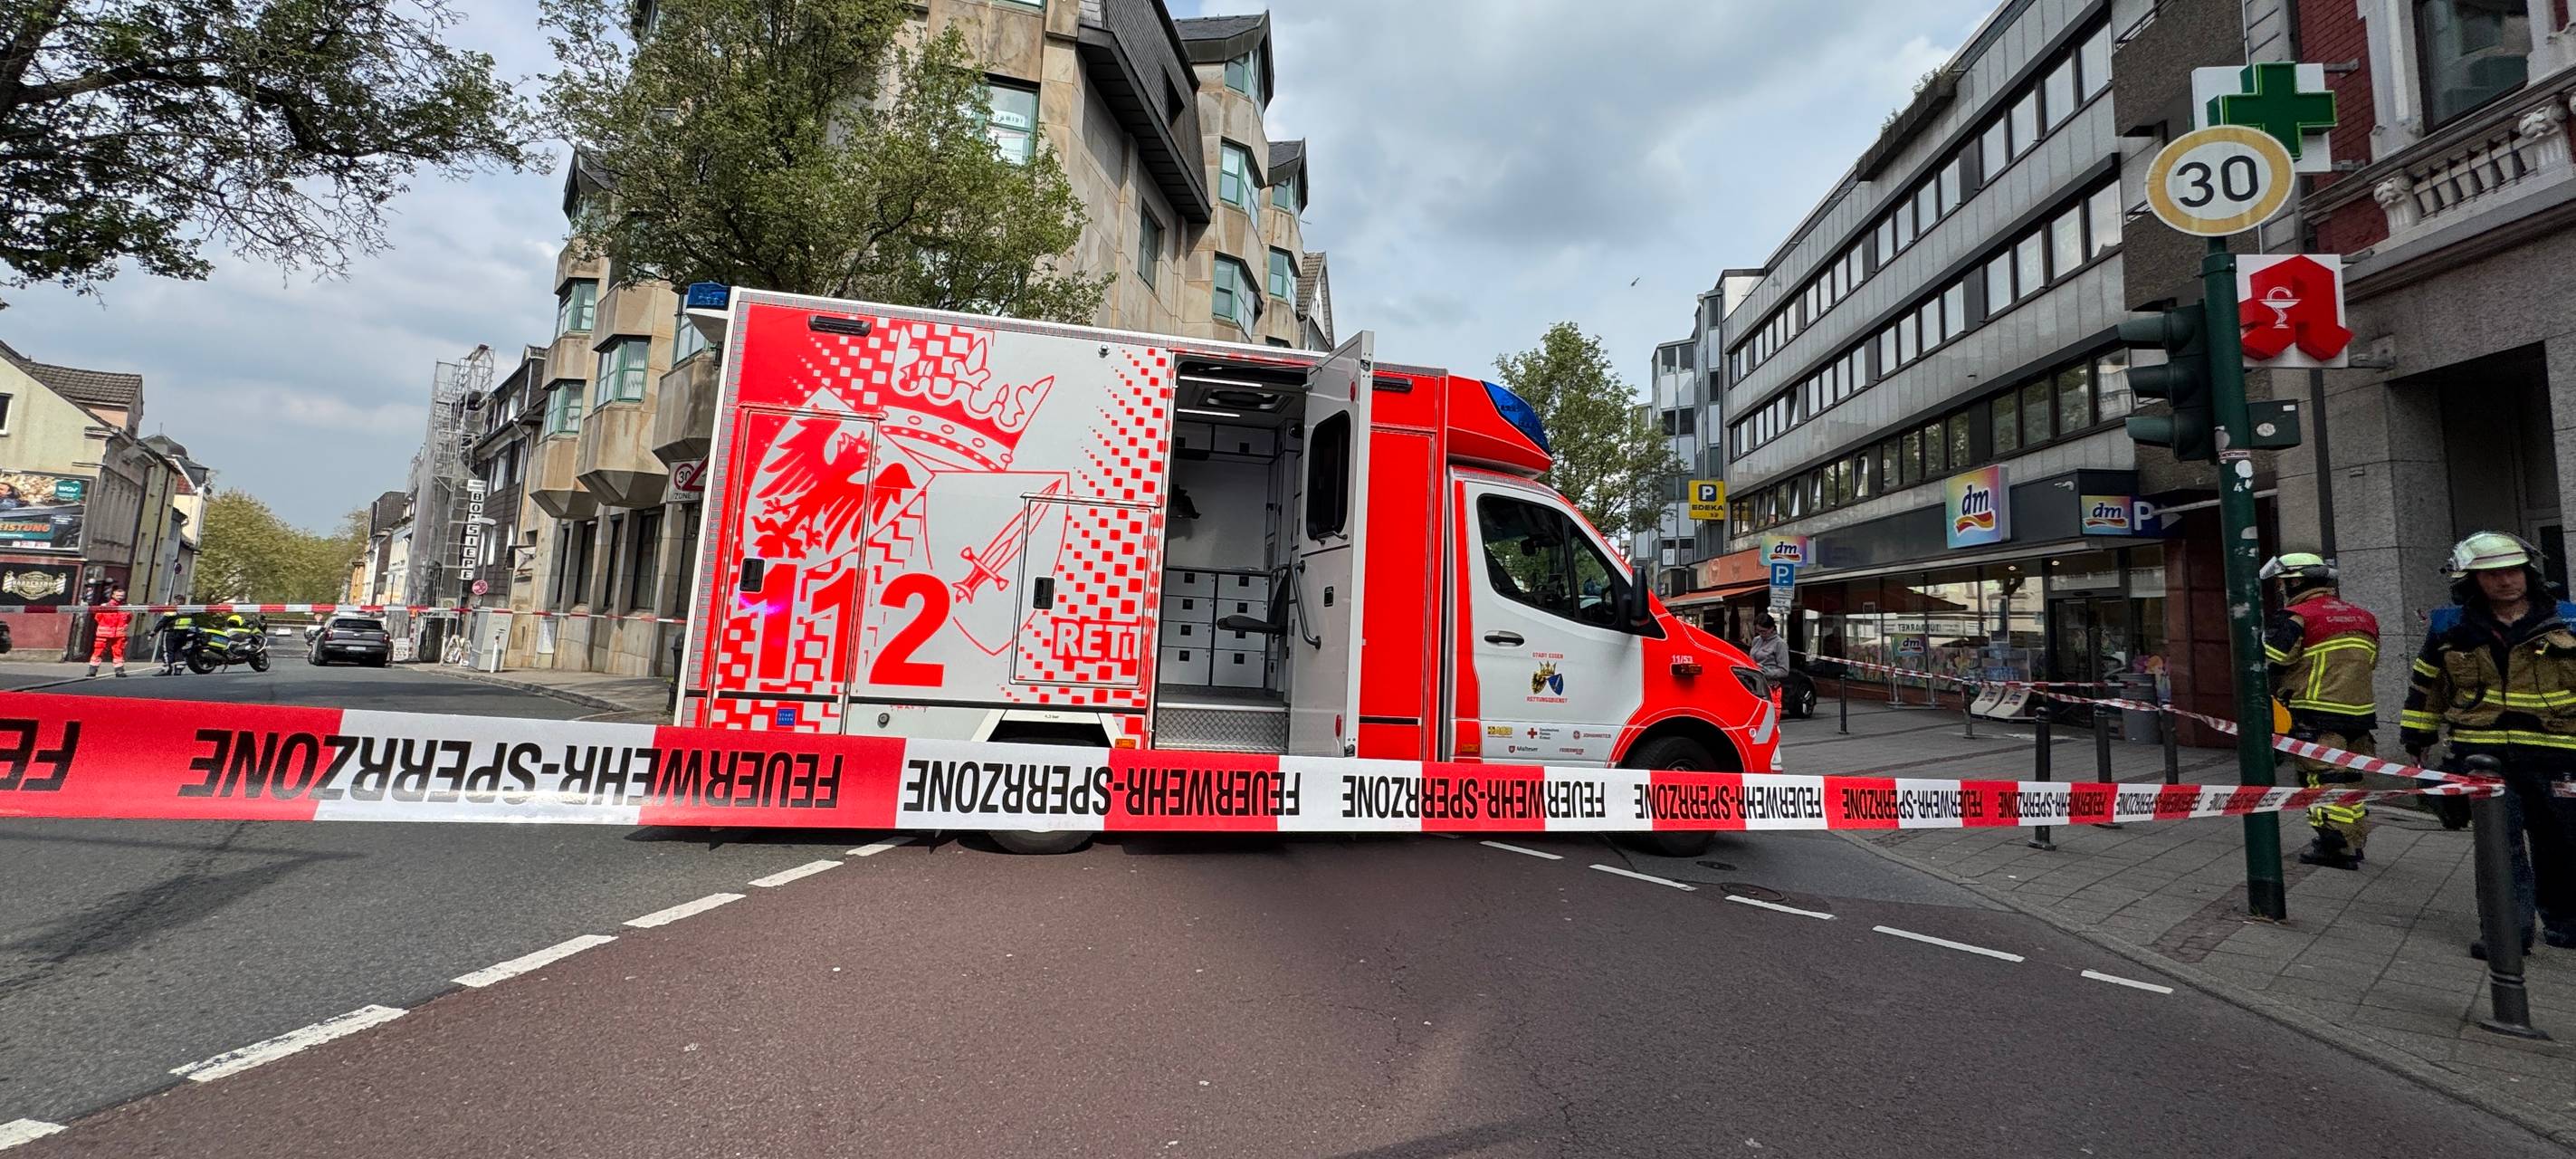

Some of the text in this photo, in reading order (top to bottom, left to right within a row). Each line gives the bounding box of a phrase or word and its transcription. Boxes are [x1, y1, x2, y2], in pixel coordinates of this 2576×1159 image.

[2176, 155, 2259, 207] 30
[1702, 485, 1713, 501] P
[1962, 485, 1989, 516] dm
[2092, 503, 2122, 518] dm
[2133, 502, 2155, 531] P
[1775, 541, 1797, 554] dm
[1776, 565, 1789, 584] P
[738, 563, 950, 687] 112
[1903, 637, 1920, 647] dm
[1672, 654, 1693, 664] 11/53
[181, 728, 844, 809] FEUERWEHR-SPERRZONE
[903, 759, 1301, 816] FEUERWEHR-SPERRZONE
[1341, 775, 1606, 819] FEUERWEHR-SPERRZONE
[1634, 783, 1823, 819] FEUERWEHR-SPERRZONE
[1842, 788, 1983, 819] FEUERWEHR-SPERRZONE
[1999, 790, 2106, 818] FEUERWEHR-SPERRZONE
